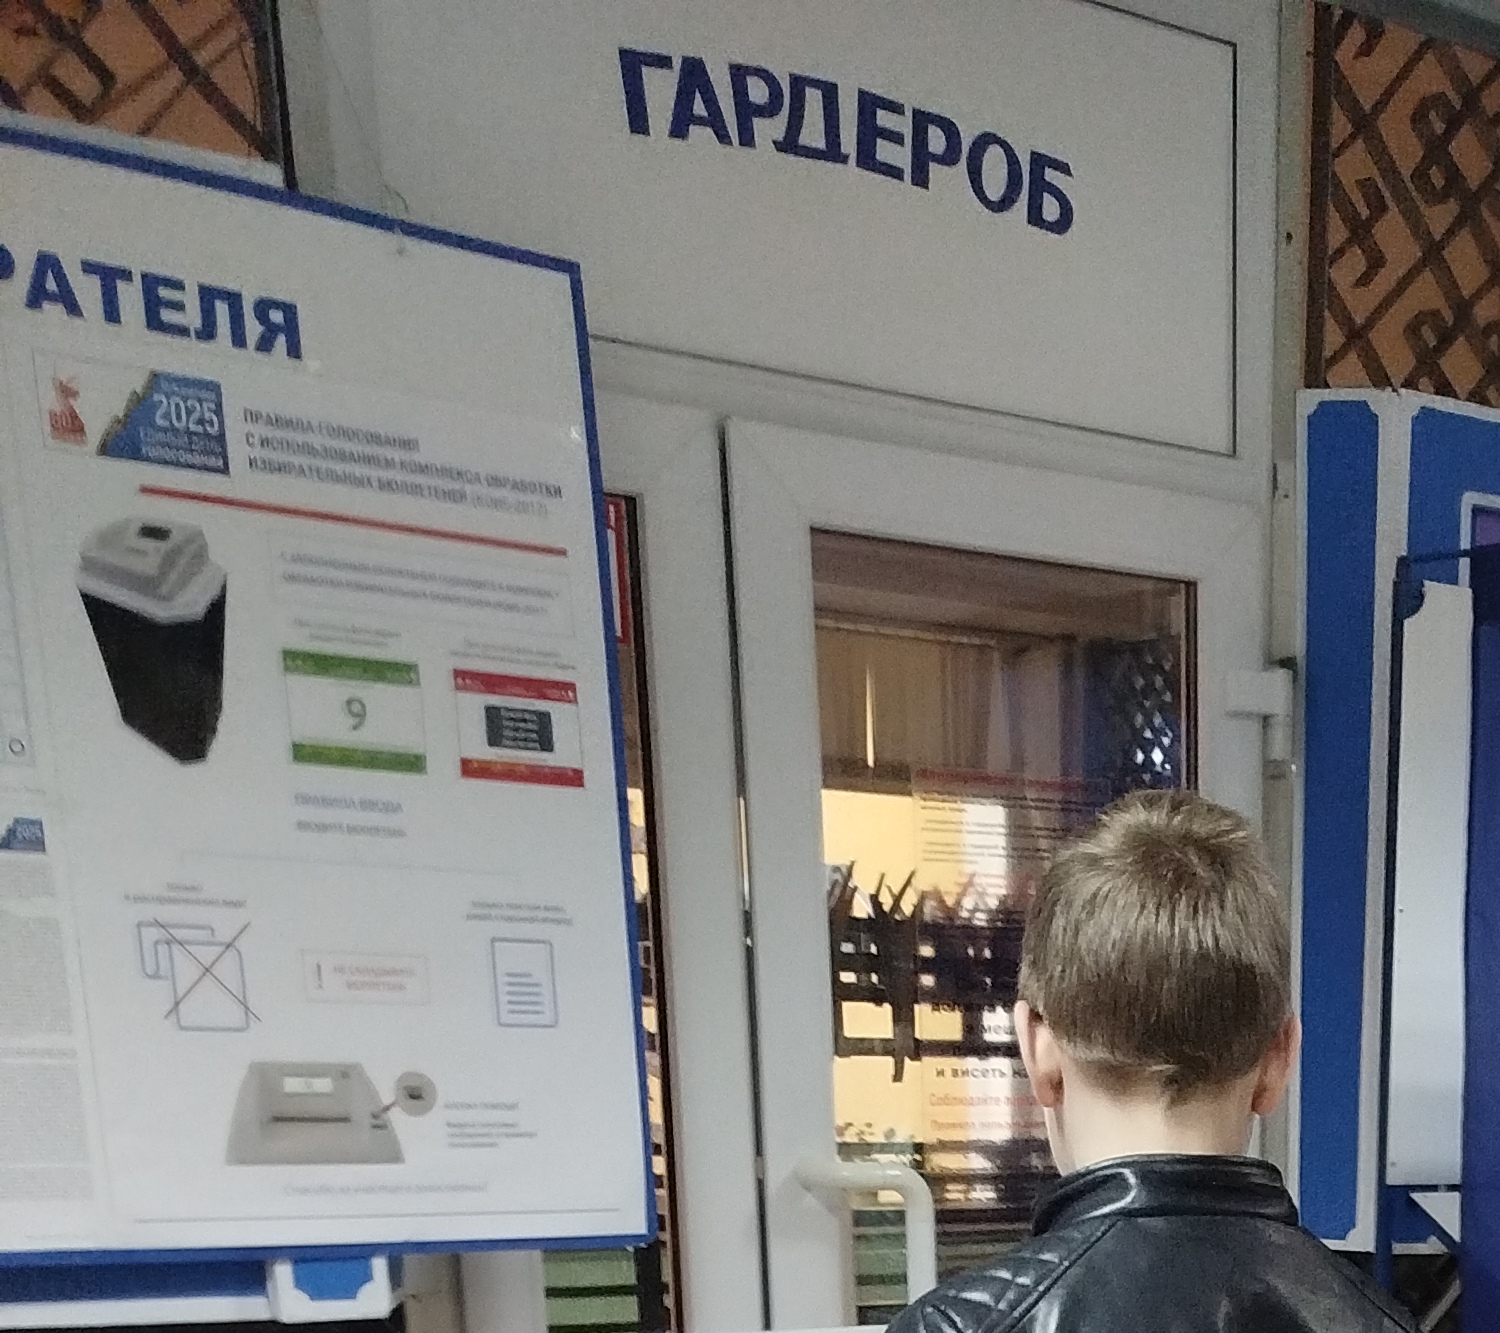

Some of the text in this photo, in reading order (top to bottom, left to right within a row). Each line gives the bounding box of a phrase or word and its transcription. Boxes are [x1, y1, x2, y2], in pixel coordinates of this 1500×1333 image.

[617, 46, 1075, 236] ГАРДЕРОБ
[153, 392, 219, 436] 2025
[243, 406, 420, 452] ПРАВИЛА ГОЛОСОВАНИЯ
[248, 455, 374, 490] ИЗБИРАТЕЛЬНЫХ
[378, 477, 468, 504] БЮЛЛЕТЕНЕЙ
[259, 433, 396, 470] ИСПОЛЬЗОВАНИЕМ
[400, 457, 482, 486] КОМПЛЕКСА
[485, 471, 563, 499] ОБРАБОТКИ
[346, 697, 367, 730] 9
[951, 1067, 1007, 1079] висеть
